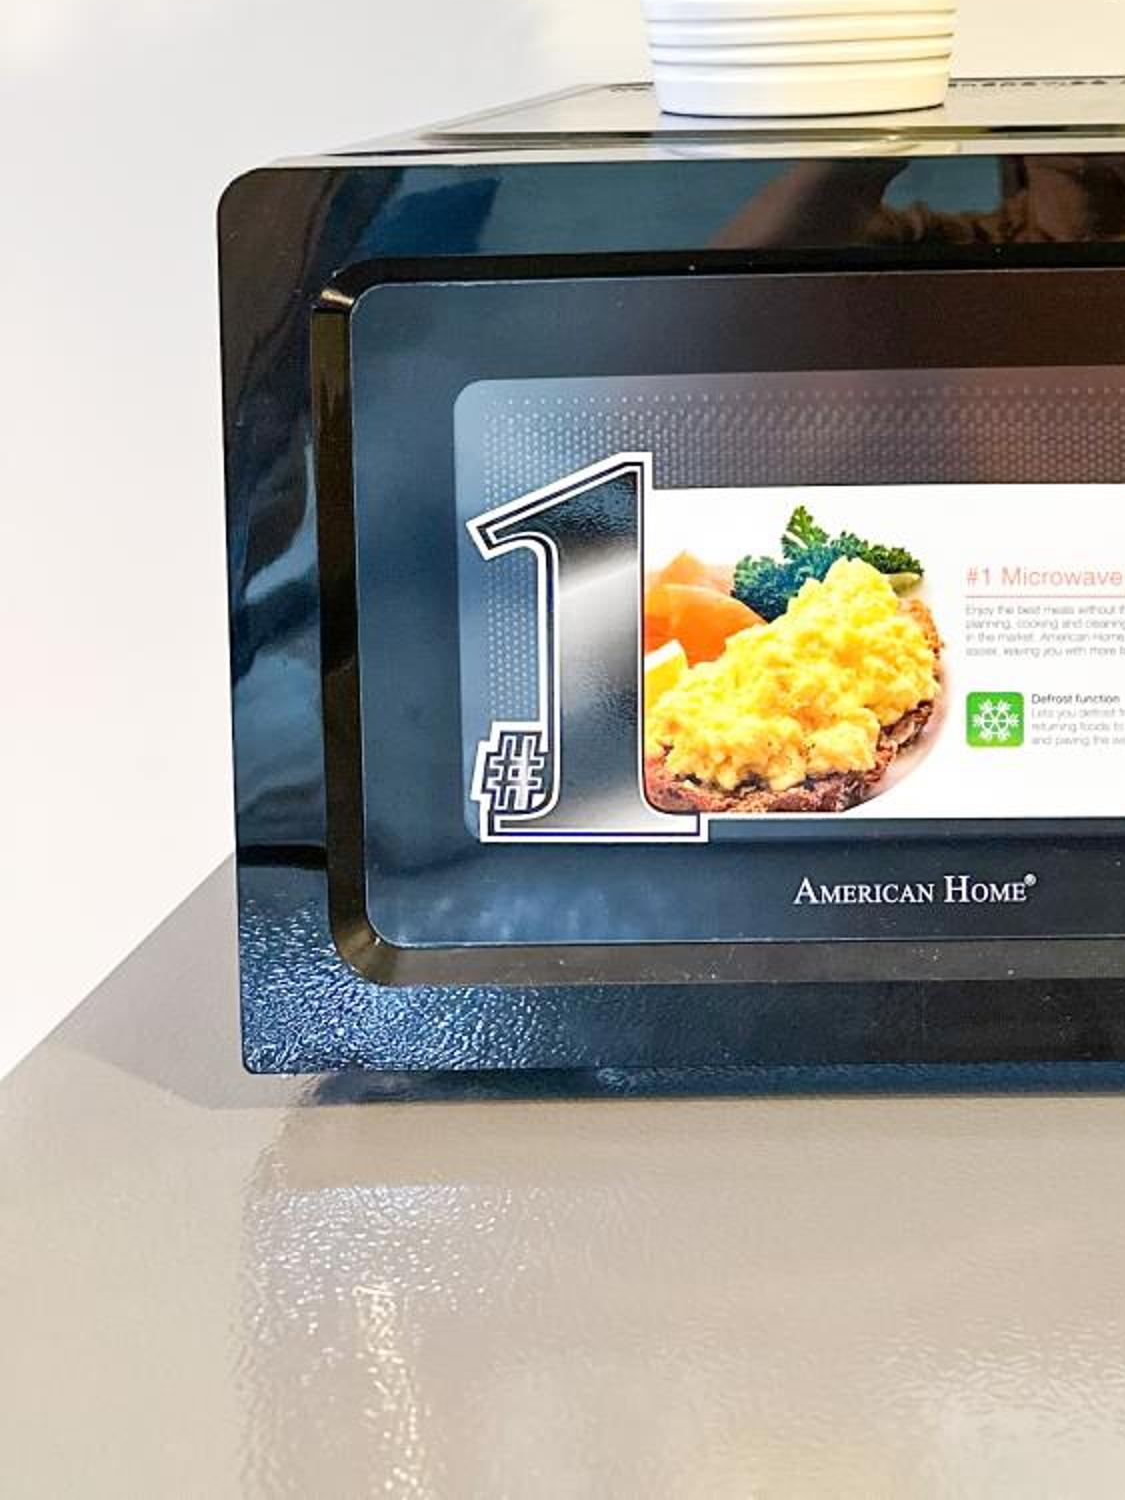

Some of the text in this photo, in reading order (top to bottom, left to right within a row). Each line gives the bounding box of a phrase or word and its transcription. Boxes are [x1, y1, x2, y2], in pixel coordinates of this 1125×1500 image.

[966, 567, 991, 586] #1
[1002, 566, 1123, 586] Microwave
[965, 605, 994, 616] Enjoy
[998, 605, 1015, 616] the
[1017, 605, 1041, 616] best
[1043, 605, 1075, 616] meals
[1078, 605, 1116, 616] without
[1016, 619, 1058, 630] cooking
[1062, 619, 1082, 630] and
[966, 632, 975, 643] in
[978, 632, 995, 643] the
[1040, 632, 1089, 643] American
[1093, 632, 1124, 643] Home
[1043, 646, 1062, 657] you
[1065, 646, 1087, 657] with
[1090, 646, 1117, 657] more
[1031, 694, 1120, 704] Defrost function
[794, 877, 935, 905] AMERICAN
